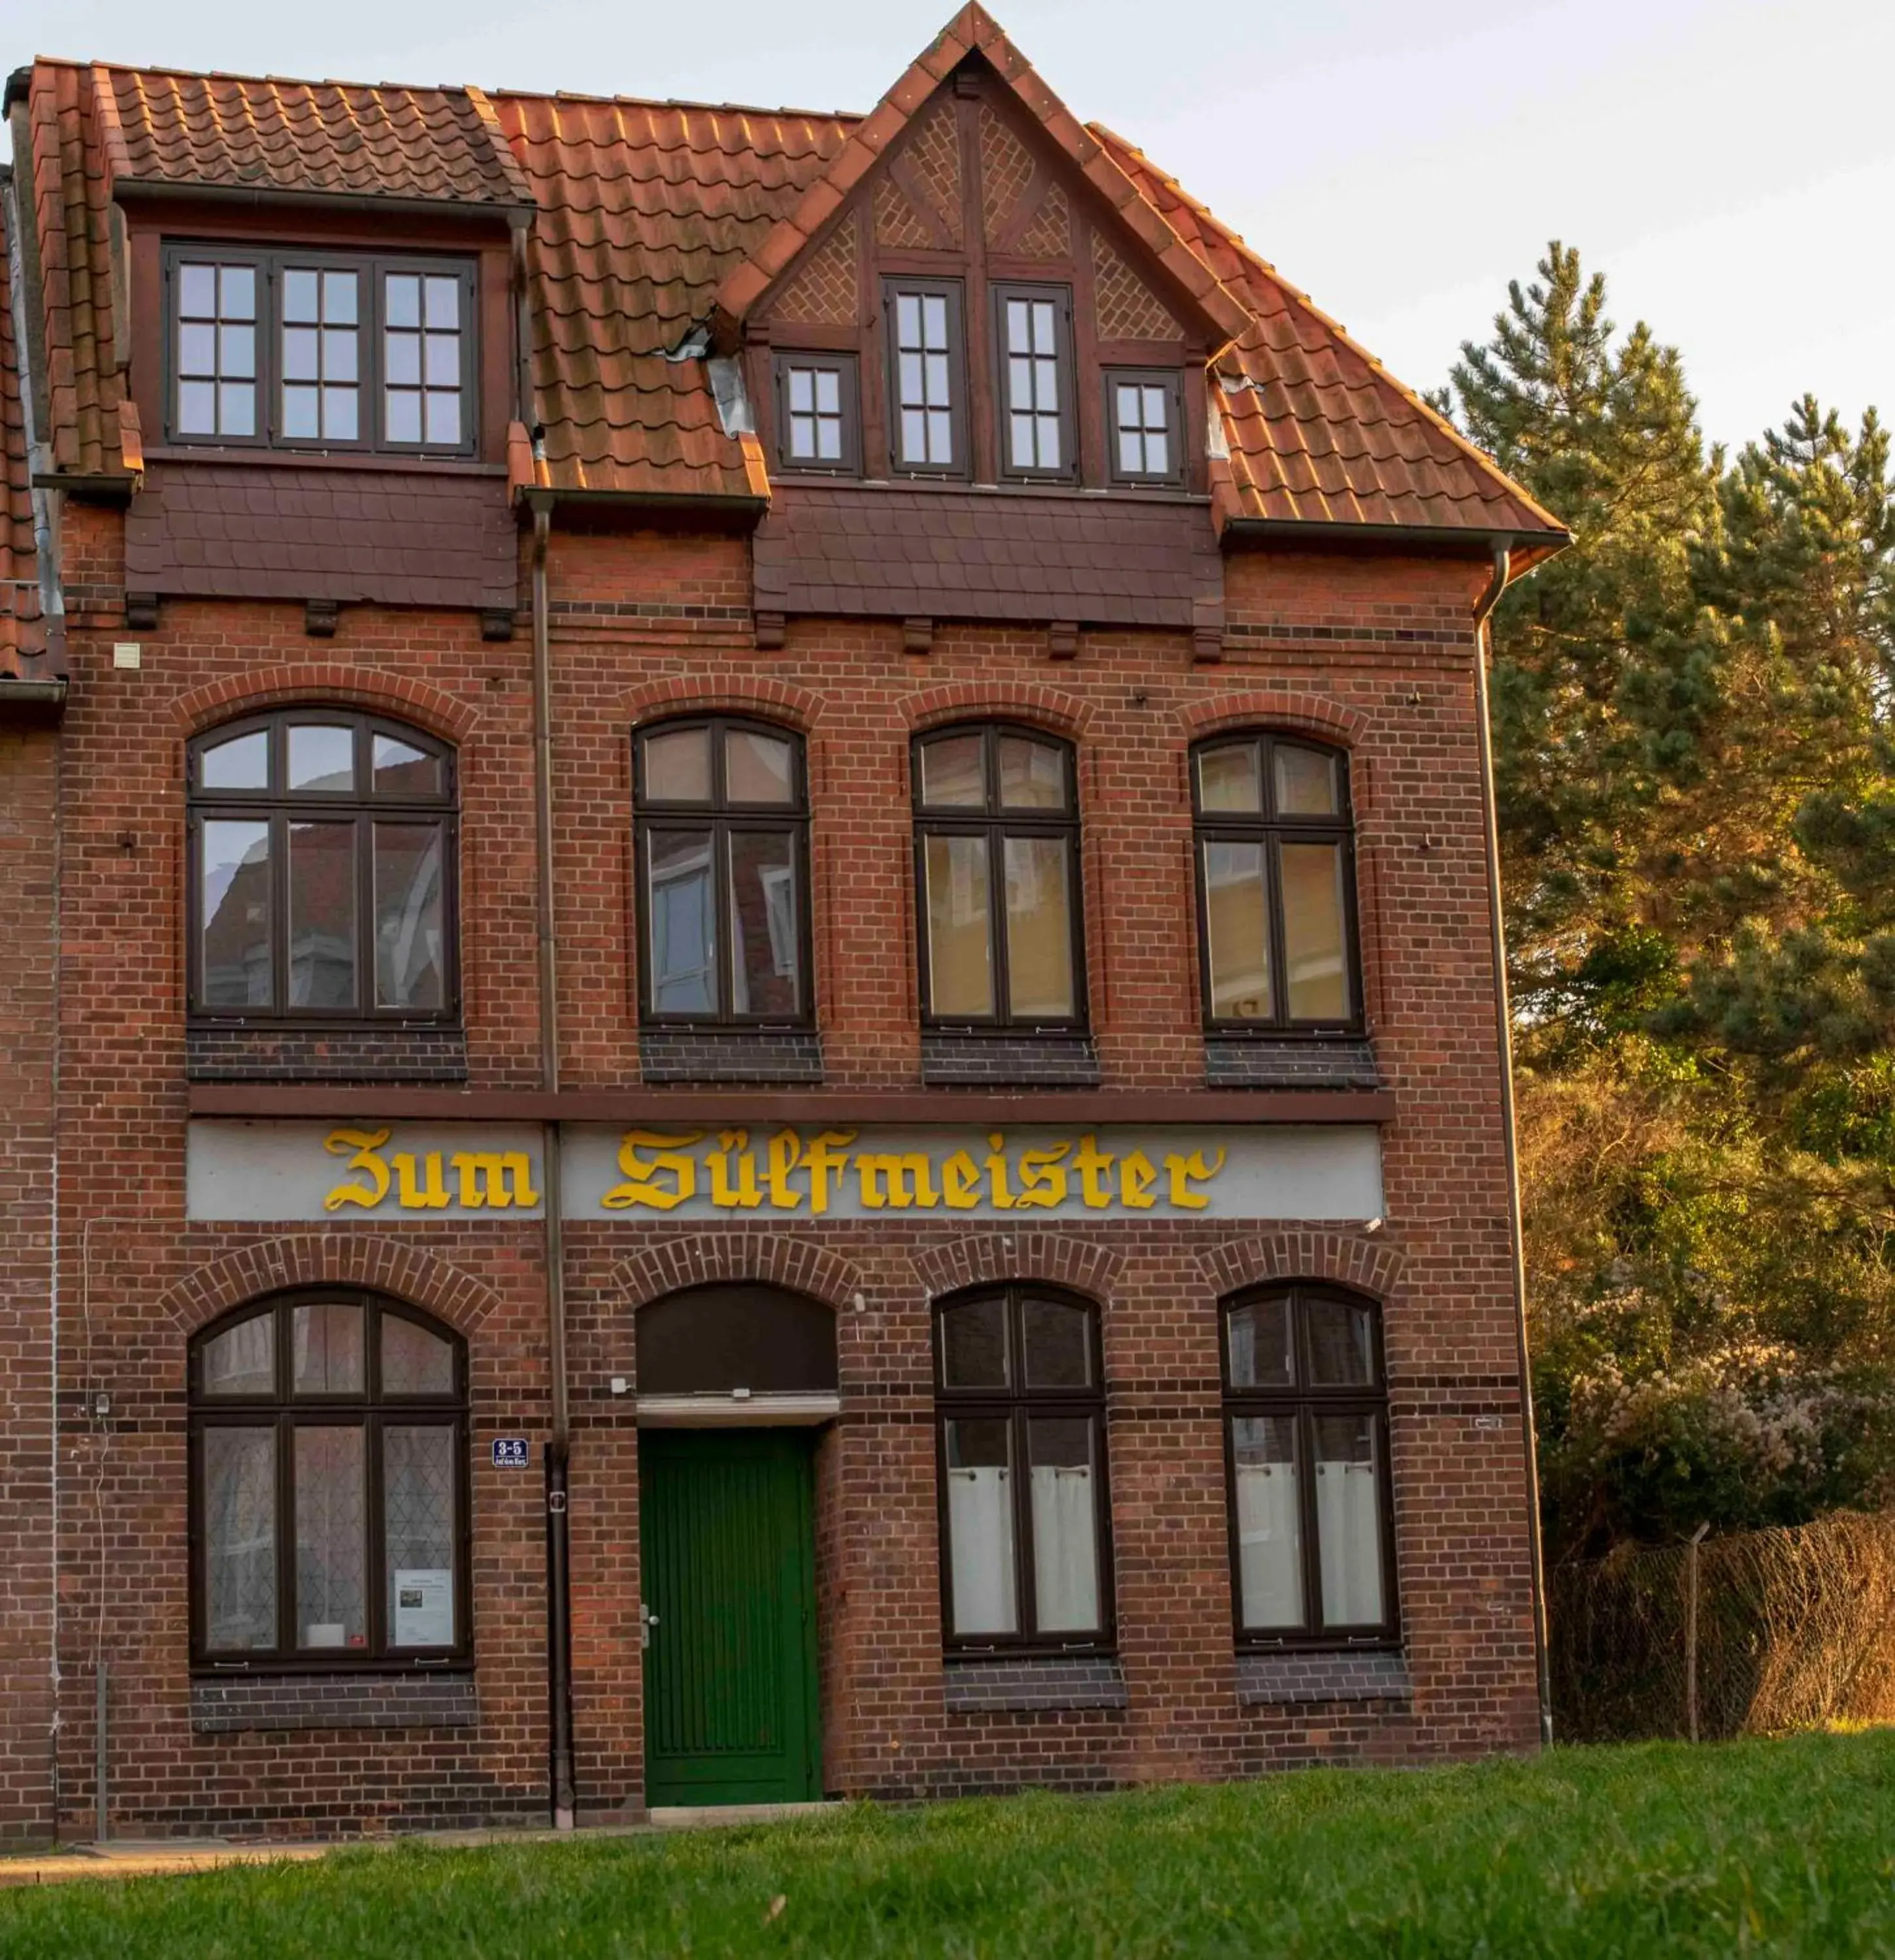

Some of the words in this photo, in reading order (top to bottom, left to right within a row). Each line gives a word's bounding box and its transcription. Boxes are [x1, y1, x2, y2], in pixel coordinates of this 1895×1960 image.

[323, 1128, 540, 1211] Zum
[601, 1128, 1226, 1215] Sülfmeister
[499, 1442, 522, 1456] 3-5
